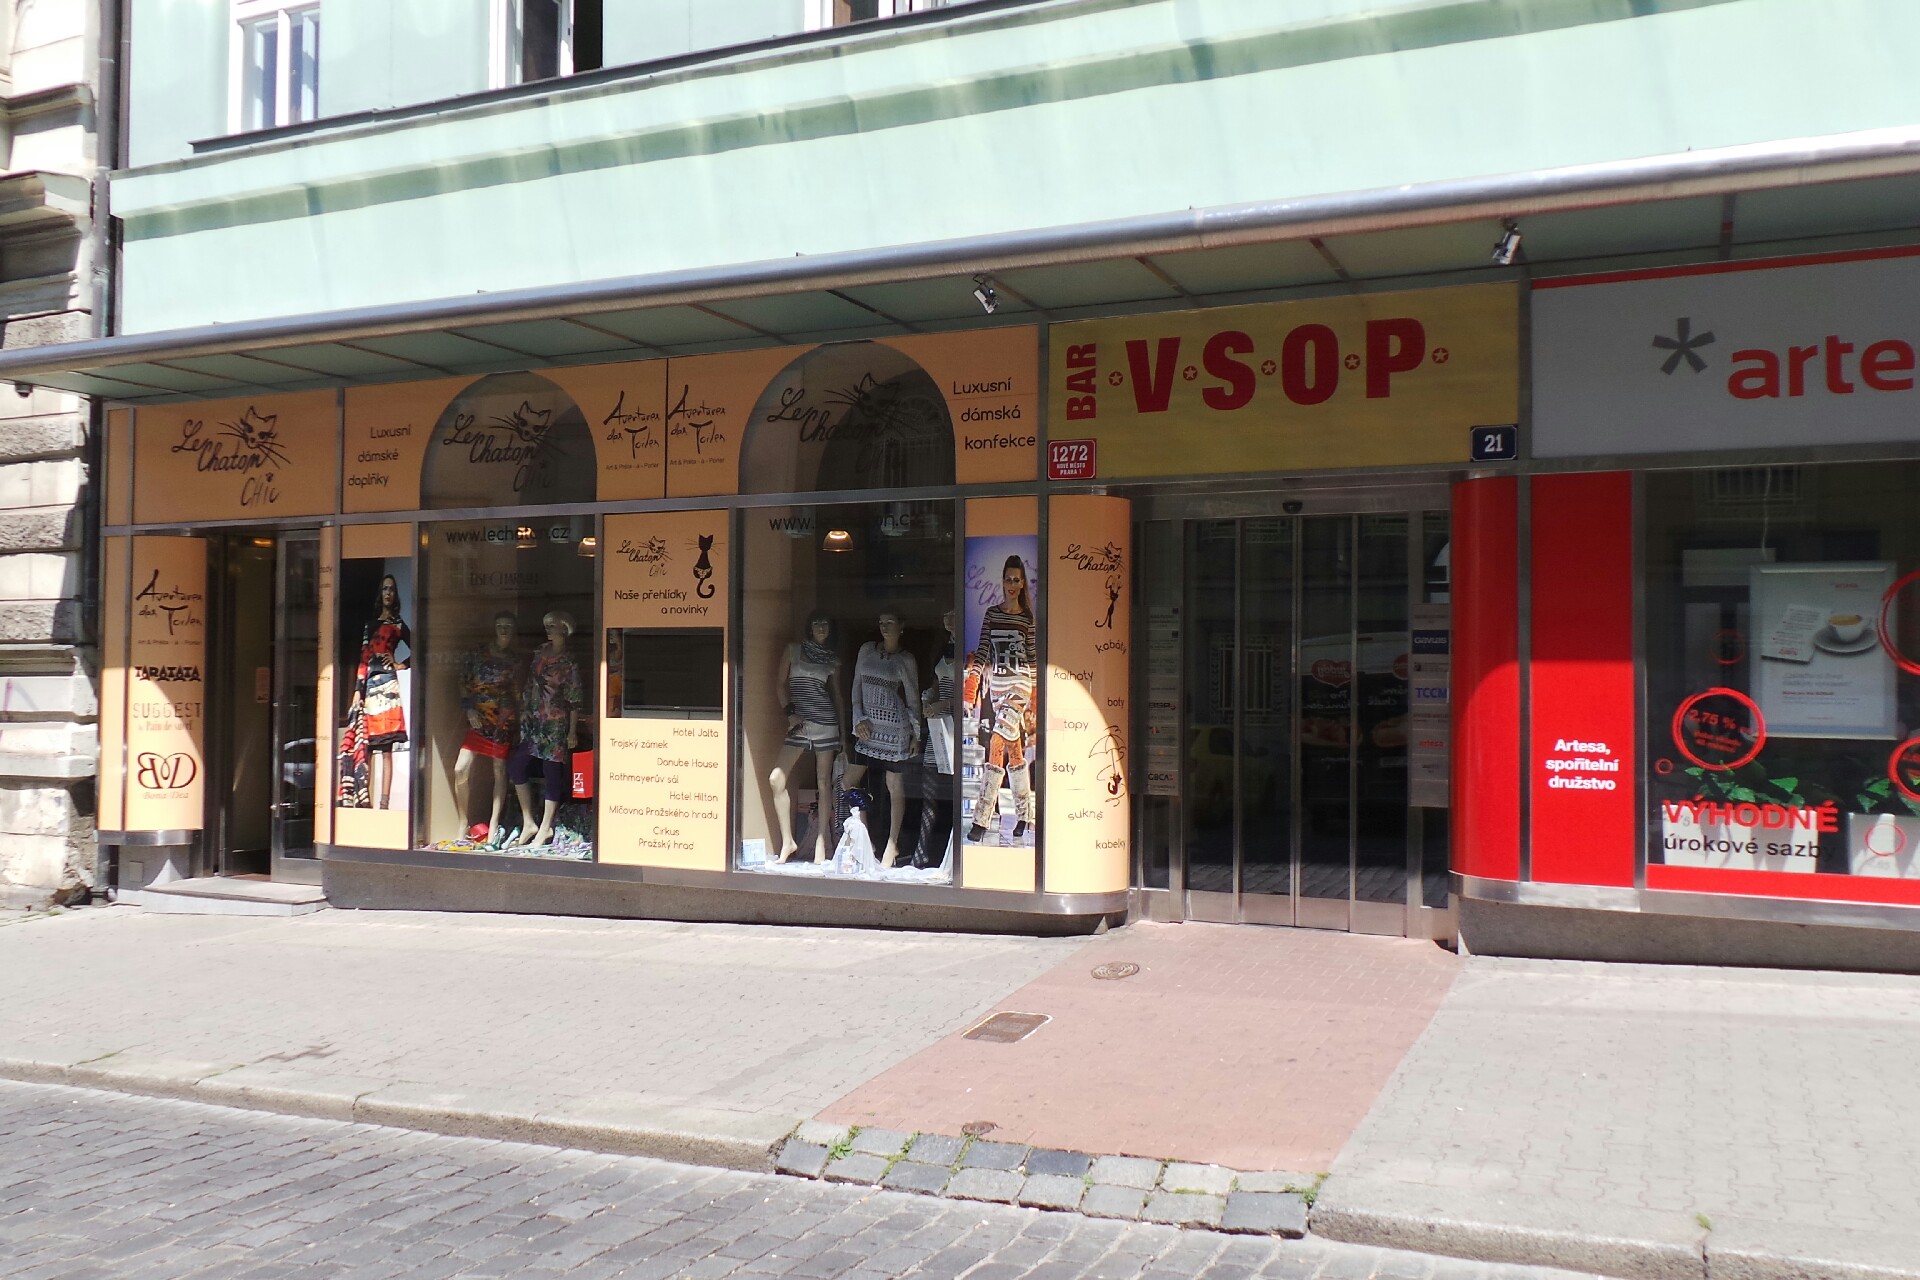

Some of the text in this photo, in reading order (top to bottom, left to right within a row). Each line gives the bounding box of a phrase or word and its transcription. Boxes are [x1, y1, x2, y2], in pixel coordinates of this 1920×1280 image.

[953, 377, 1012, 395] Luxusní
[1066, 342, 1097, 420] BAR
[961, 405, 1021, 422] dámská
[369, 424, 411, 440] Luxusní
[964, 434, 1036, 451] konfekce
[1484, 434, 1504, 453] 21
[357, 449, 399, 463] dámské
[1053, 445, 1088, 463] 1272
[347, 473, 389, 489] doplňky
[614, 589, 688, 602] Naše přehlídky
[661, 604, 709, 616] a novinky
[135, 665, 202, 682] TARATATA
[1053, 668, 1094, 681] kalhoty
[133, 702, 201, 718] SUGGEST
[1107, 697, 1125, 709] boty
[673, 728, 719, 738] Hotel Jalta
[1063, 719, 1089, 732] topy
[610, 738, 668, 750] Trojský zámek
[1555, 739, 1611, 756] Artesa,
[657, 757, 719, 769] Danube House
[1052, 763, 1077, 775] šaty
[1545, 758, 1619, 773] spořitelní
[667, 775, 679, 784] sál
[1548, 776, 1616, 791] družstvo
[669, 791, 719, 802] Hotel Hilton
[609, 805, 718, 820] Míčovna Pražského hradu
[1067, 808, 1103, 821] sukně
[1662, 794, 1839, 833] VÝHODNÉ
[653, 826, 680, 836] Cirkus
[639, 838, 695, 851] Pražský hrad
[1664, 832, 1759, 855] úrokové
